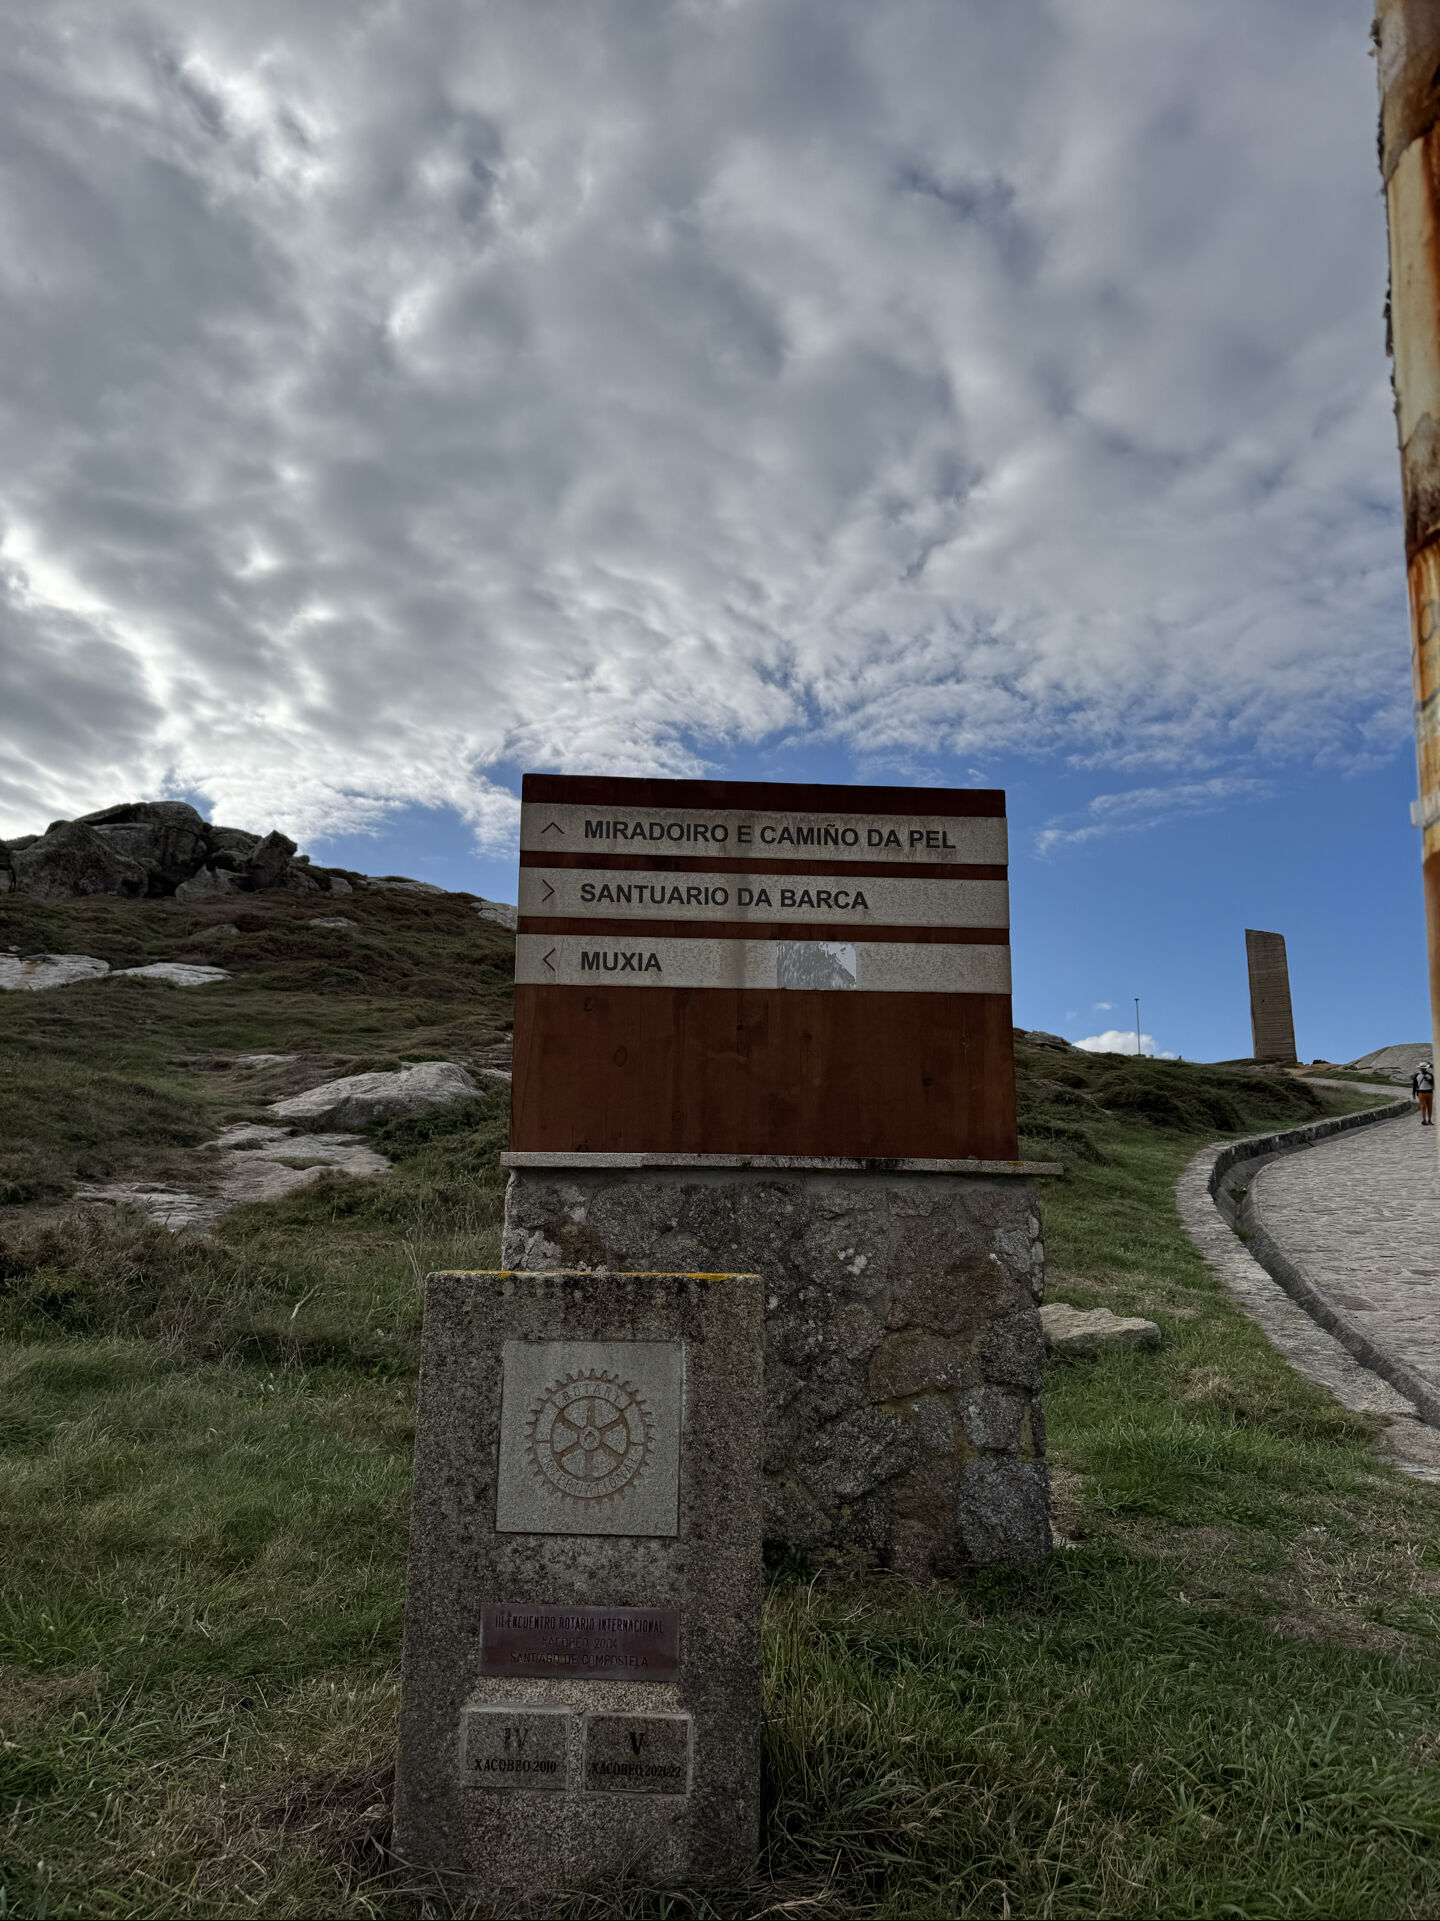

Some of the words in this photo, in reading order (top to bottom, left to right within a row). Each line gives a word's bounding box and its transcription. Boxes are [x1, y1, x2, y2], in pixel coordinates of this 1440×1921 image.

[584, 820, 729, 843] MIRADOIRO
[737, 824, 752, 843] E
[760, 822, 859, 847] CAMIÑO
[867, 828, 900, 847] DA
[909, 830, 956, 849] PEL
[580, 883, 729, 906] SANTUARIO
[737, 888, 772, 907] DA
[780, 890, 869, 910] BARCA
[580, 951, 662, 971] MUXIA
[562, 1383, 621, 1403] ROTARY
[559, 1617, 595, 1632] ROTARIO
[599, 1618, 664, 1634] INTERNACIONAL
[510, 1652, 560, 1665] SANTIAGO
[564, 1655, 578, 1666] DE
[581, 1655, 649, 1667] COMPOSTELA
[629, 1732, 645, 1756] V
[475, 1758, 531, 1773] XACOBEO
[533, 1760, 557, 1773] 2010
[592, 1761, 643, 1776] XACOBEO
